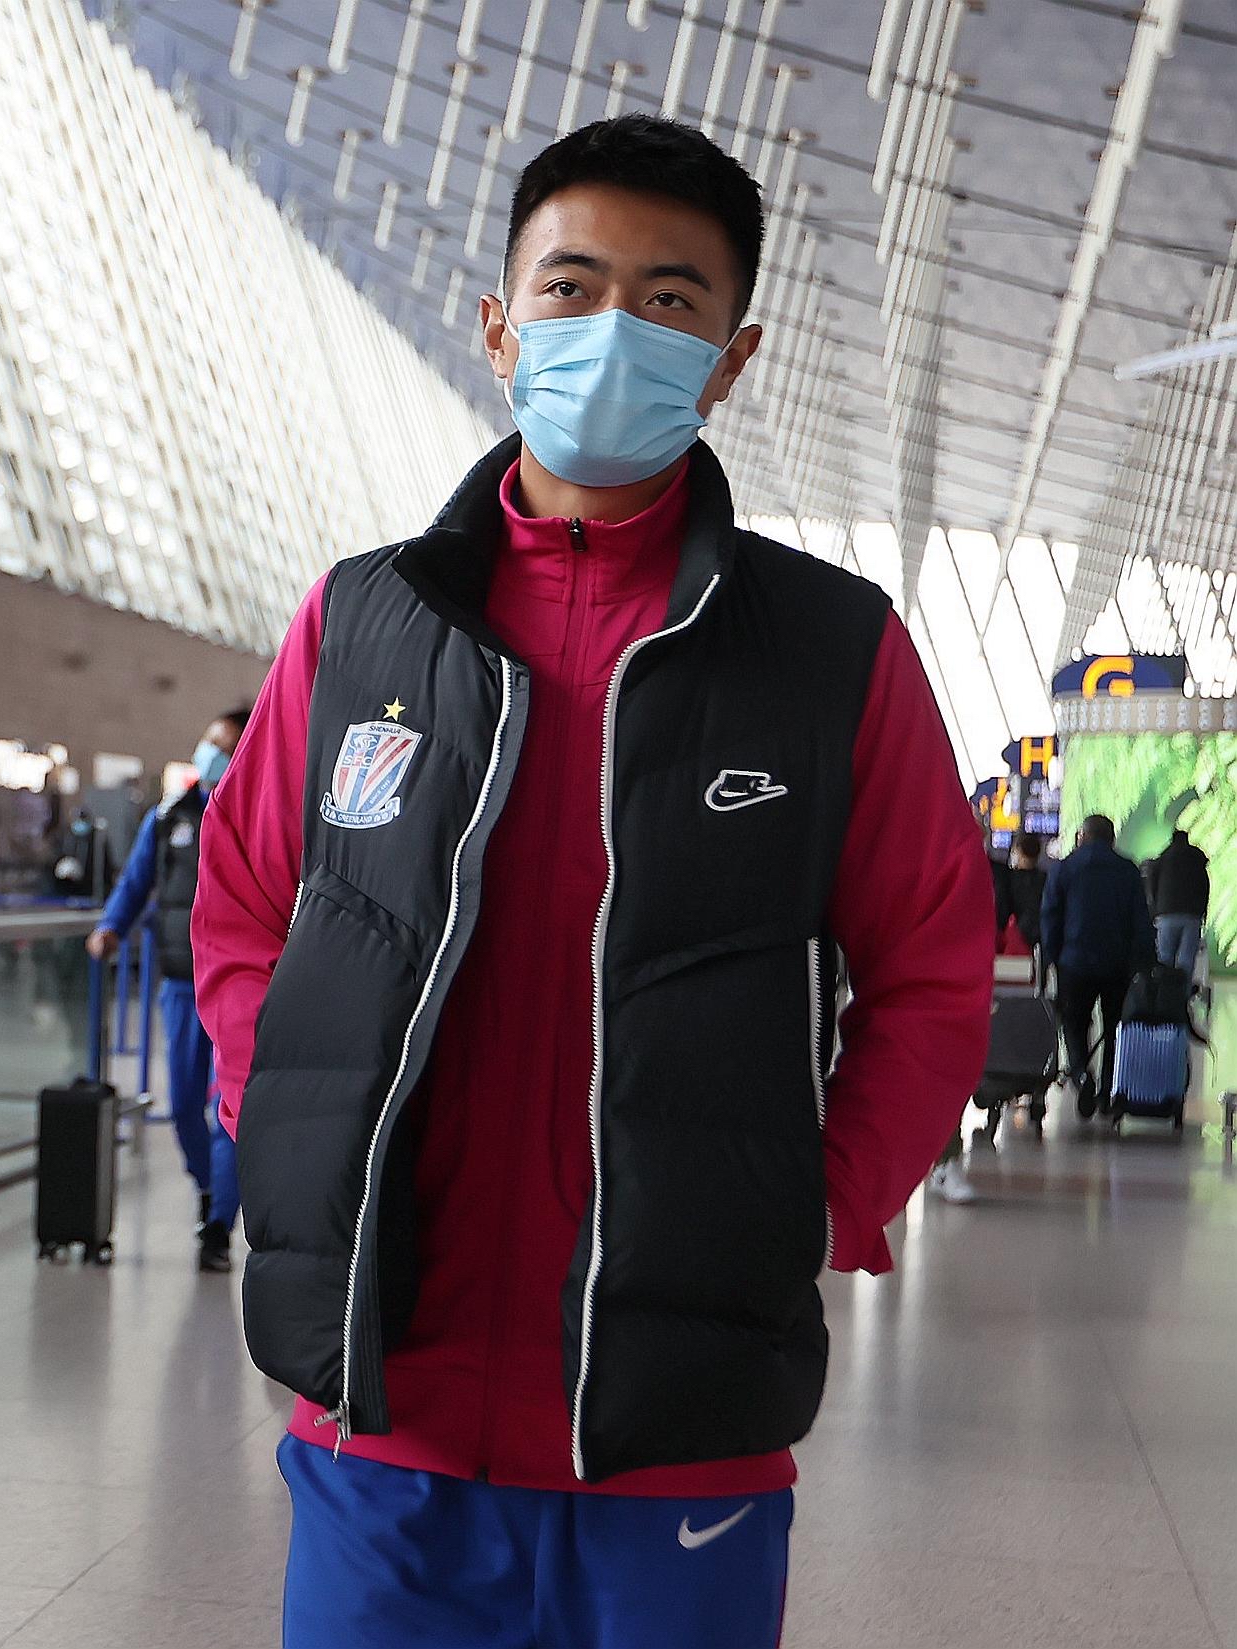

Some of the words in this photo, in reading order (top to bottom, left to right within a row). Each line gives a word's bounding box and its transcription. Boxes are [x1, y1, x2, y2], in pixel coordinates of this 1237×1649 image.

[368, 725, 402, 734] SHENHUA
[343, 755, 373, 766] SFC
[1020, 736, 1055, 778] H
